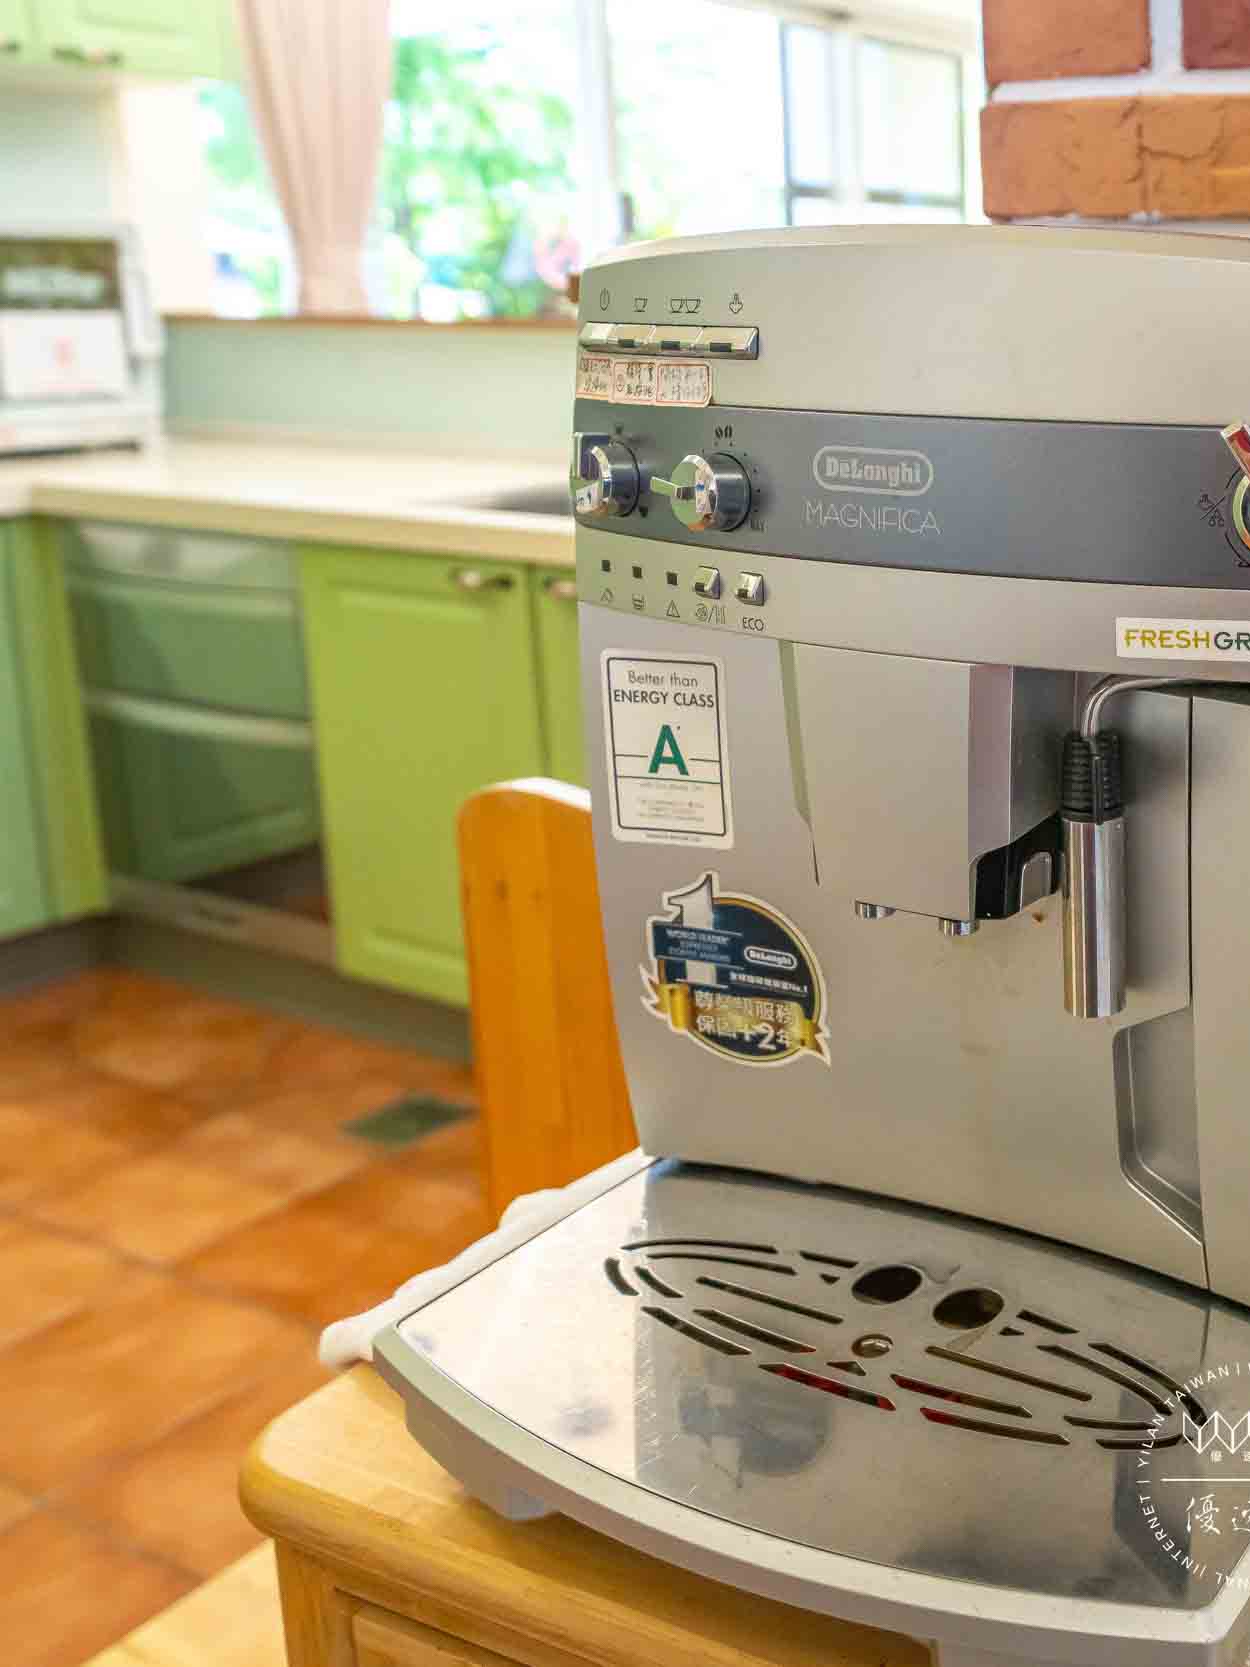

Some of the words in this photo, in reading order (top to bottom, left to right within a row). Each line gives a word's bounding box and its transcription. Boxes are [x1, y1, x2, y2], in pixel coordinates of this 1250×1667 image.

[824, 455, 922, 487] DeLonghi
[803, 501, 943, 535] MAGNIFICA
[742, 617, 765, 631] ECO
[627, 670, 665, 686] Better
[670, 671, 699, 688] than
[613, 689, 669, 705] ENERGY
[673, 691, 715, 708] CLASS
